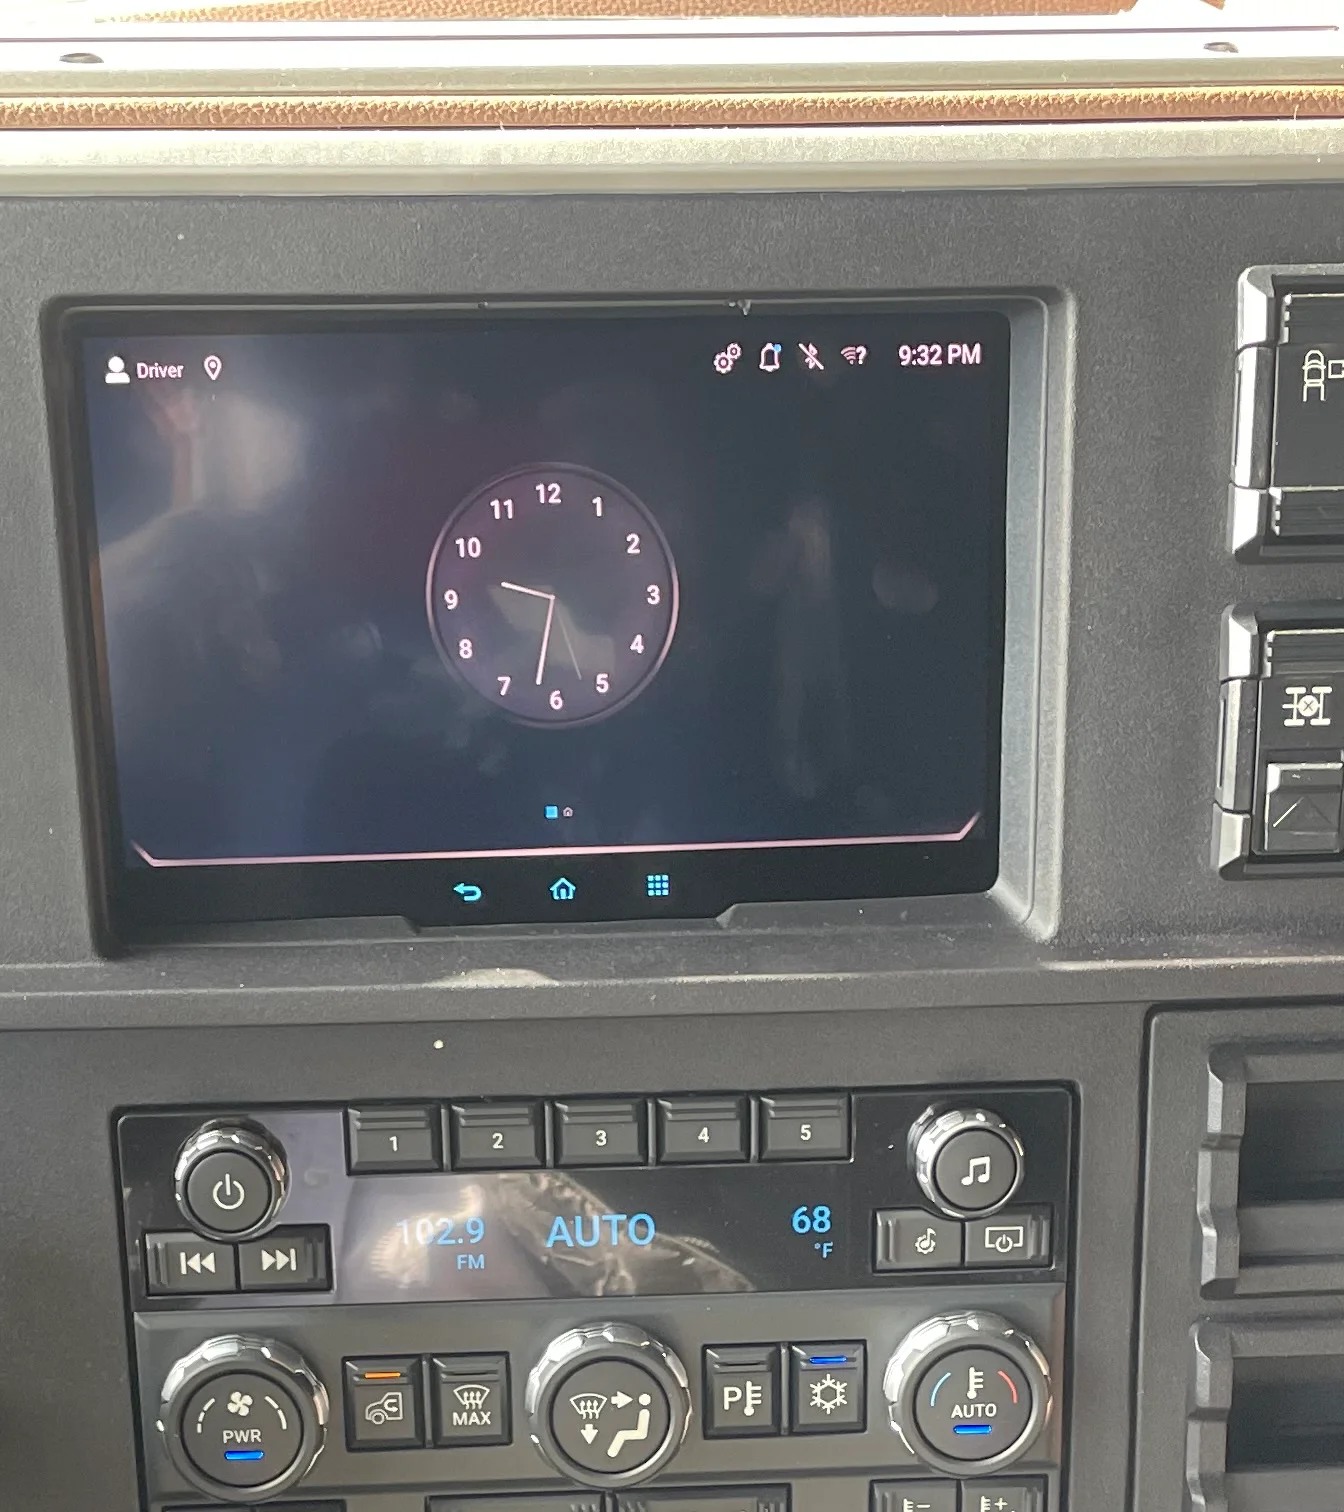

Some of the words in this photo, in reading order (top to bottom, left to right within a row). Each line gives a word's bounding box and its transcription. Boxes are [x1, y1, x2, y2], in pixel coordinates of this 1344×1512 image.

[898, 344, 942, 366] 9:32
[947, 343, 981, 365] PM
[137, 362, 184, 379] Driver
[536, 483, 562, 504] 12
[490, 499, 513, 520] 11
[593, 496, 603, 517] 1
[456, 537, 482, 558] 10
[626, 533, 640, 554] 2
[444, 589, 458, 610] 9
[647, 584, 660, 605] 3
[459, 638, 473, 659] 8
[630, 634, 644, 654] 4
[497, 676, 511, 696] 7
[596, 673, 609, 693] 5
[550, 690, 563, 710] 6
[492, 1133, 504, 1149] 2
[595, 1130, 607, 1146] 3
[698, 1127, 710, 1144] 4
[800, 1125, 812, 1141] 5
[389, 1136, 398, 1152] 1
[792, 1205, 832, 1234] 68
[396, 1216, 485, 1246] 102.9
[546, 1213, 656, 1248] AUTO
[456, 1254, 485, 1270] FM
[452, 1411, 491, 1426] MAX
[951, 1403, 997, 1419] AUTO
[222, 1429, 262, 1444] PWR
